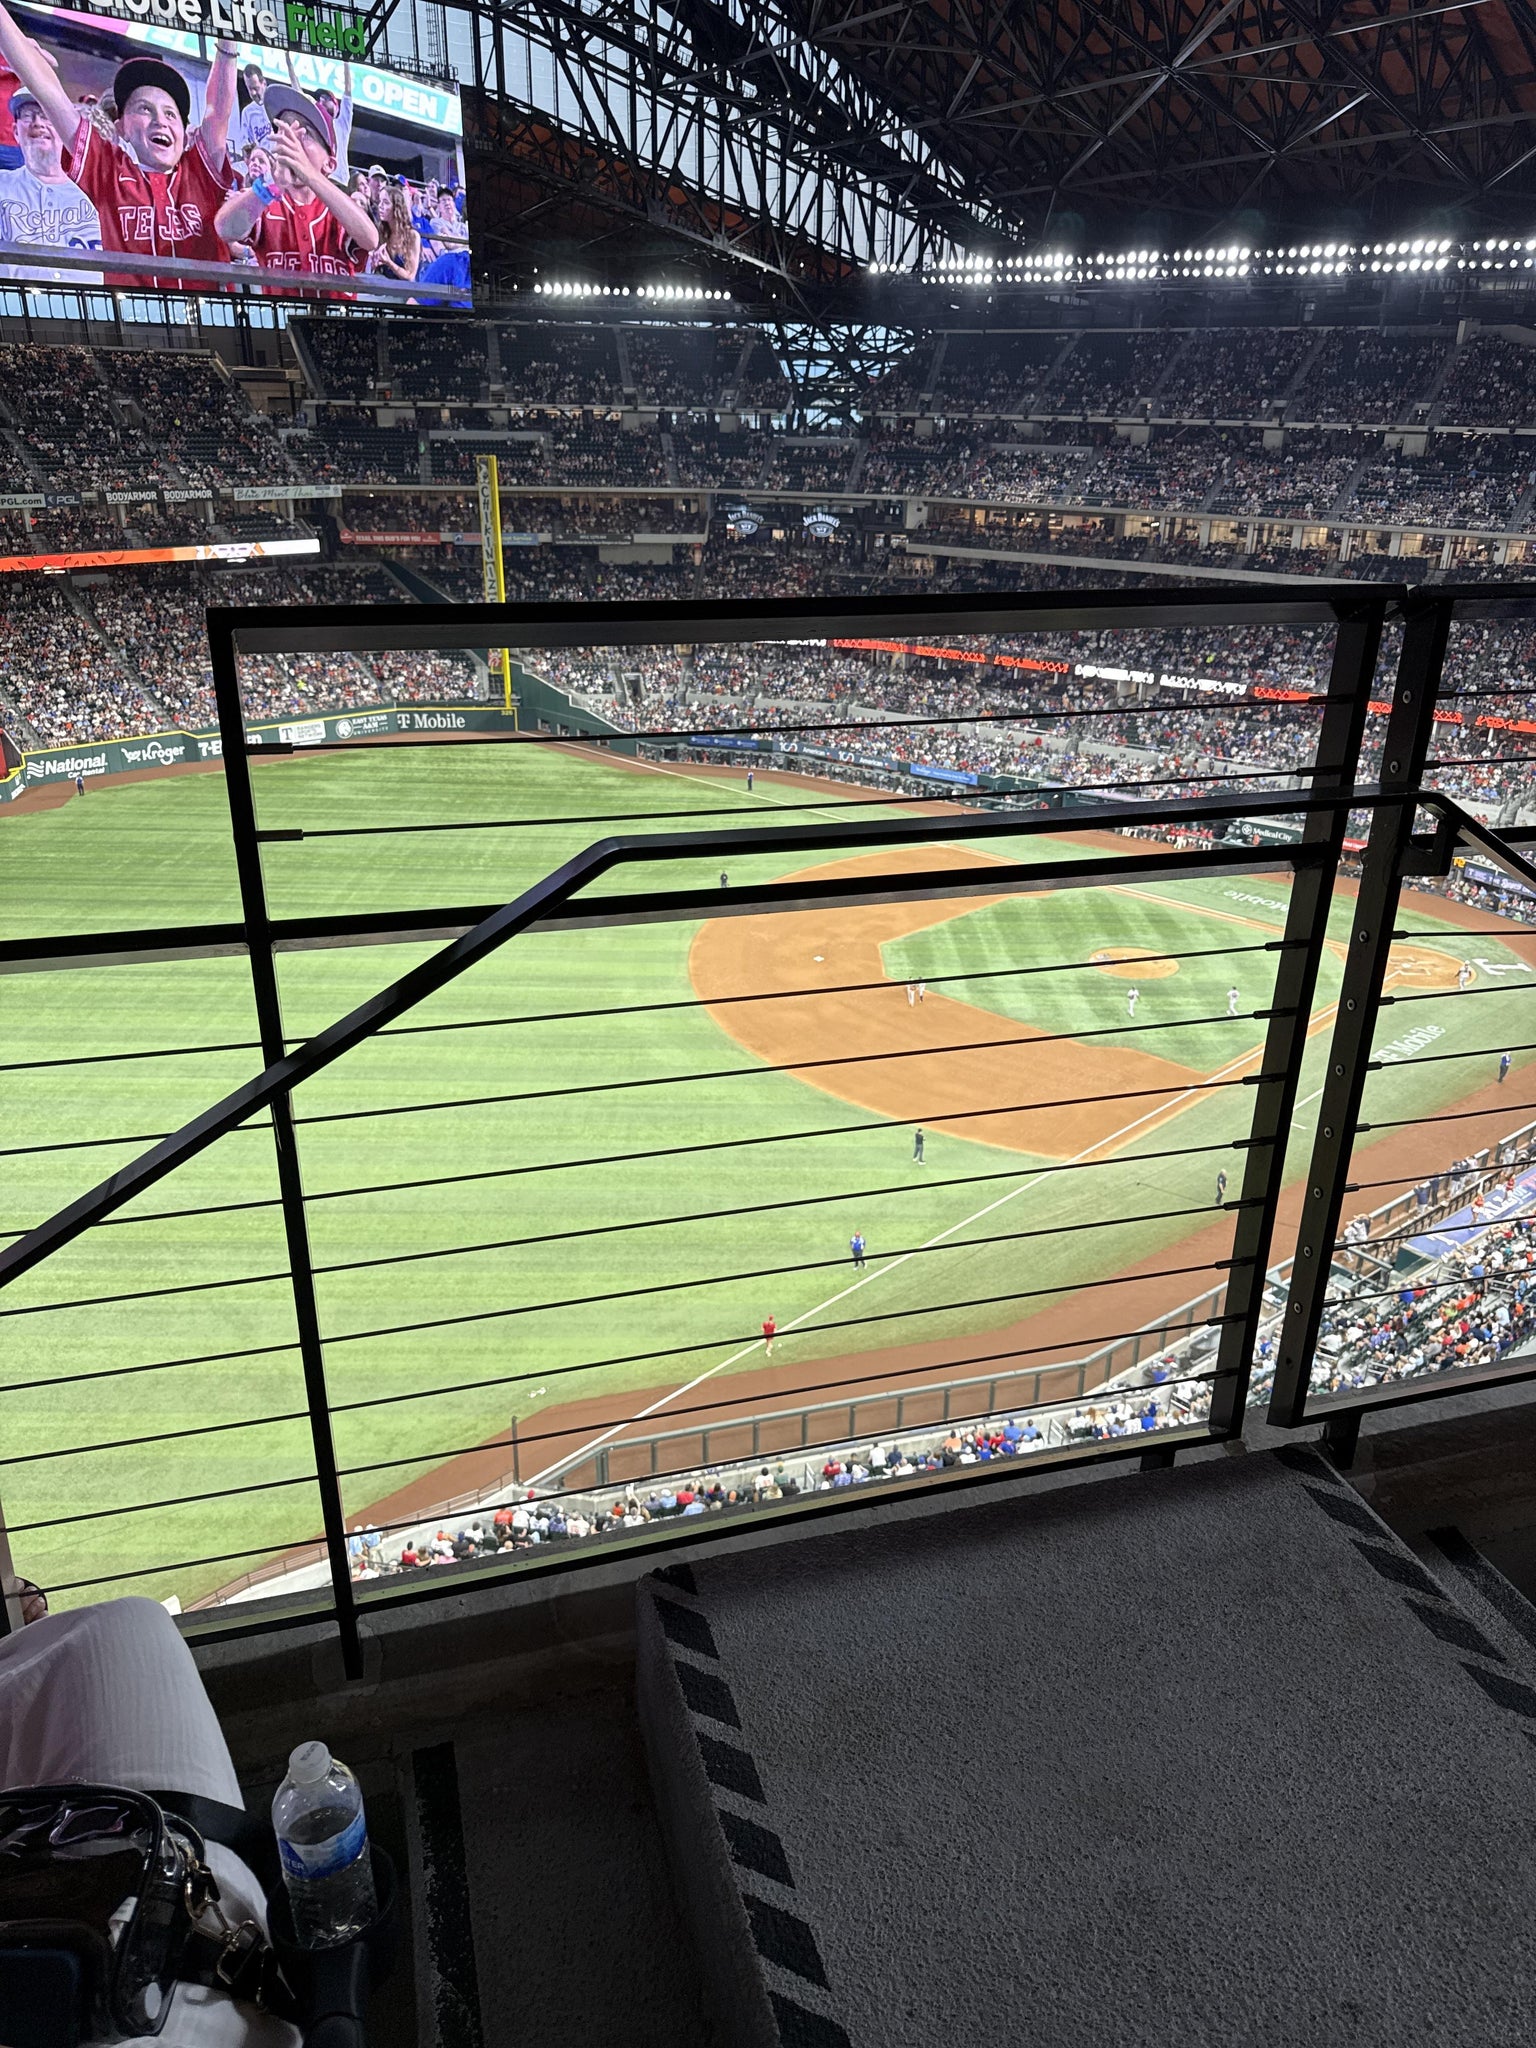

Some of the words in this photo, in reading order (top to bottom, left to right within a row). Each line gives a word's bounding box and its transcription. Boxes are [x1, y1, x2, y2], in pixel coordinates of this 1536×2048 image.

[88, 0, 201, 24] obe
[211, 0, 278, 38] Life
[286, 3, 366, 55] Field
[362, 74, 438, 118] OPEN
[118, 203, 203, 242] TEJAS
[56, 495, 80, 504] PGL
[106, 491, 158, 502] BODYARMOR
[163, 490, 213, 500] BODYARMOR
[397, 713, 411, 729] T
[415, 713, 466, 729] Mobile
[142, 741, 185, 766] Kroger
[803, 747, 826, 757] American
[860, 757, 884, 767] American
[1253, 827, 1278, 839] Medical
[1279, 832, 1293, 843] City
[1390, 1025, 1446, 1056] Mobile
